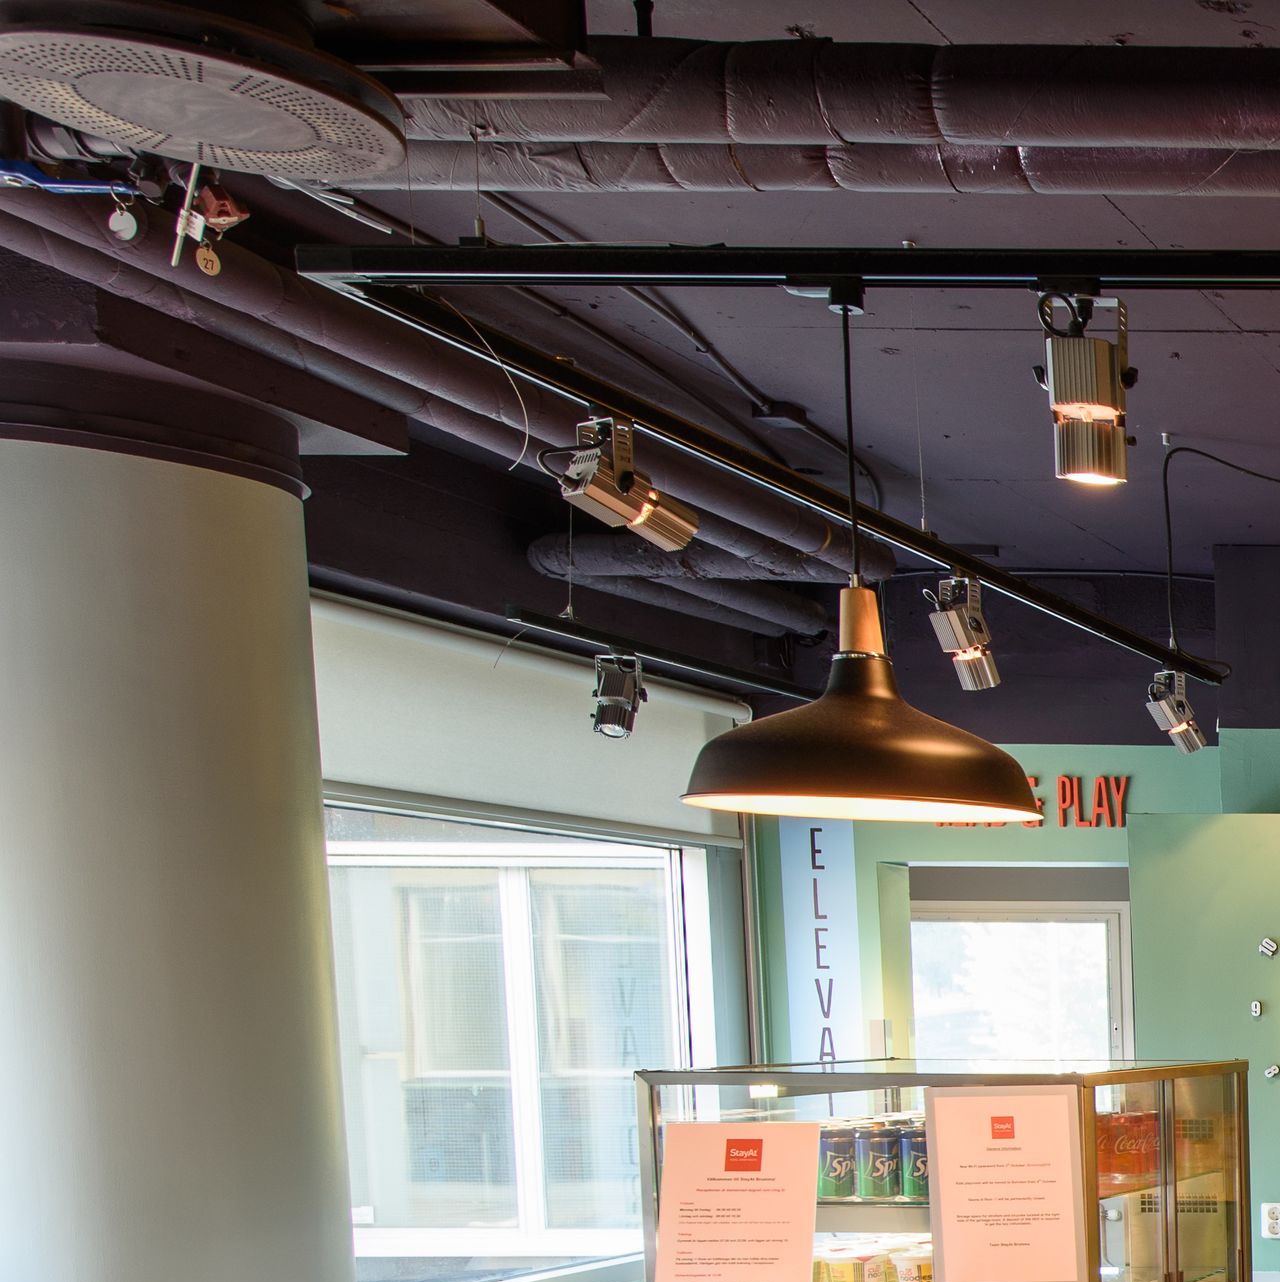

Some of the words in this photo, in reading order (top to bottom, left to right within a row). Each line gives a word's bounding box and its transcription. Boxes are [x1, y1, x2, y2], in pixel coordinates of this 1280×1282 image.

[203, 258, 214, 270] 27
[1057, 775, 1131, 828] PLAY
[1258, 937, 1278, 957] 10
[1251, 1000, 1262, 1017] 9
[1264, 1065, 1280, 1078] 8
[729, 1148, 758, 1158] StayAt
